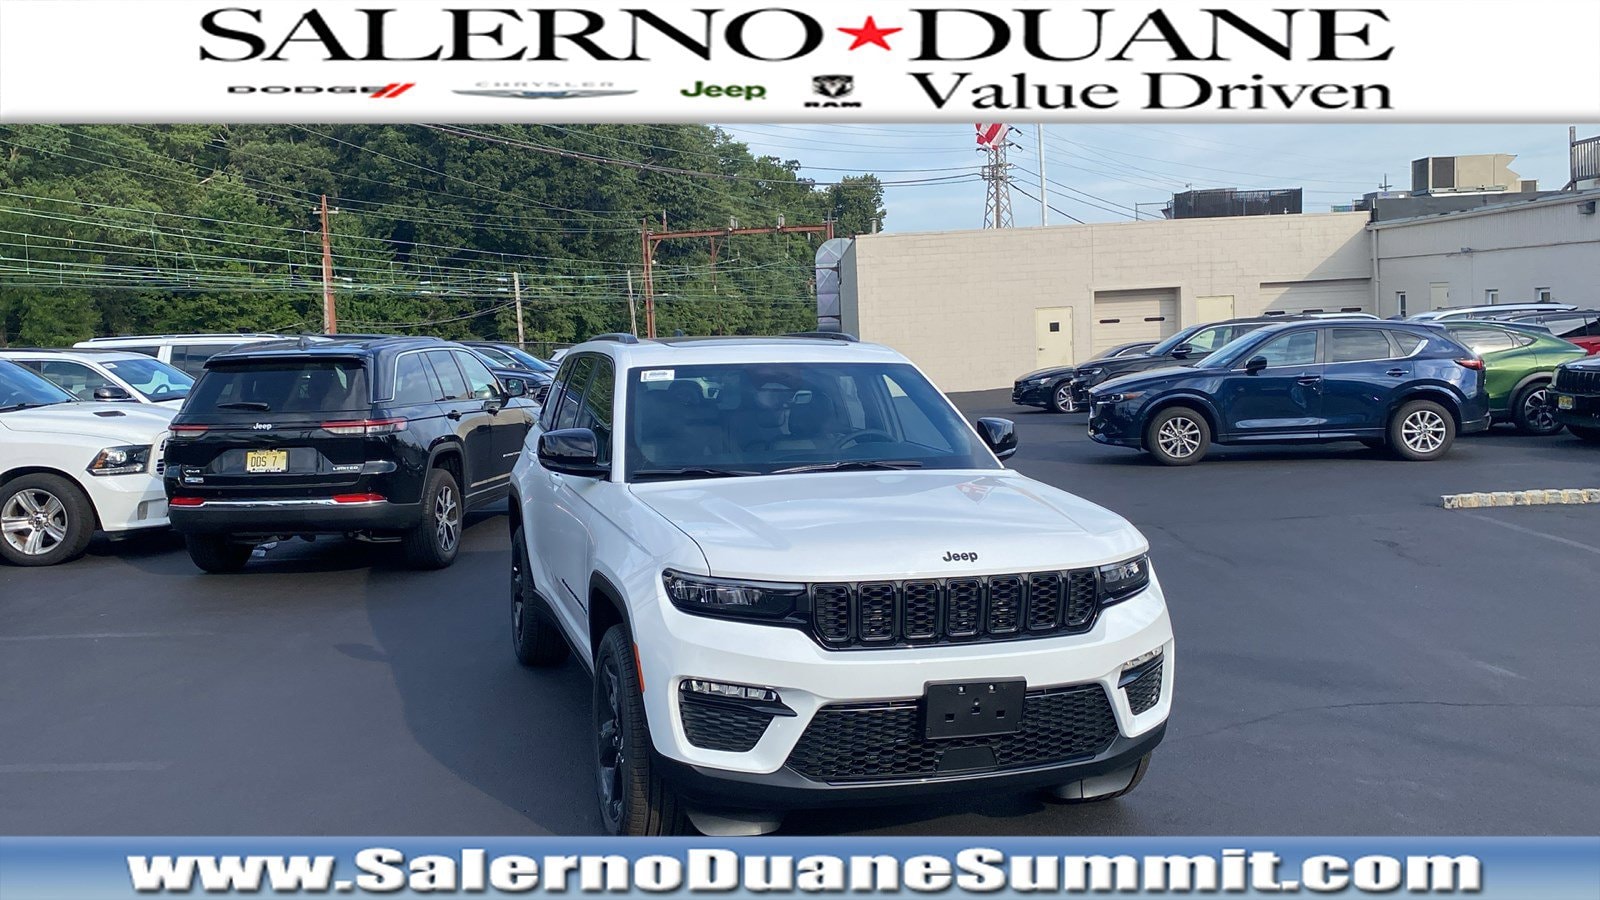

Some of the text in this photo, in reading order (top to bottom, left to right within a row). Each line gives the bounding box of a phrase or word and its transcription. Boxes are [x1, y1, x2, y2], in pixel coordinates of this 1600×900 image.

[252, 422, 272, 430] Jeep
[272, 455, 278, 467] 7
[942, 551, 978, 562] Jeep
